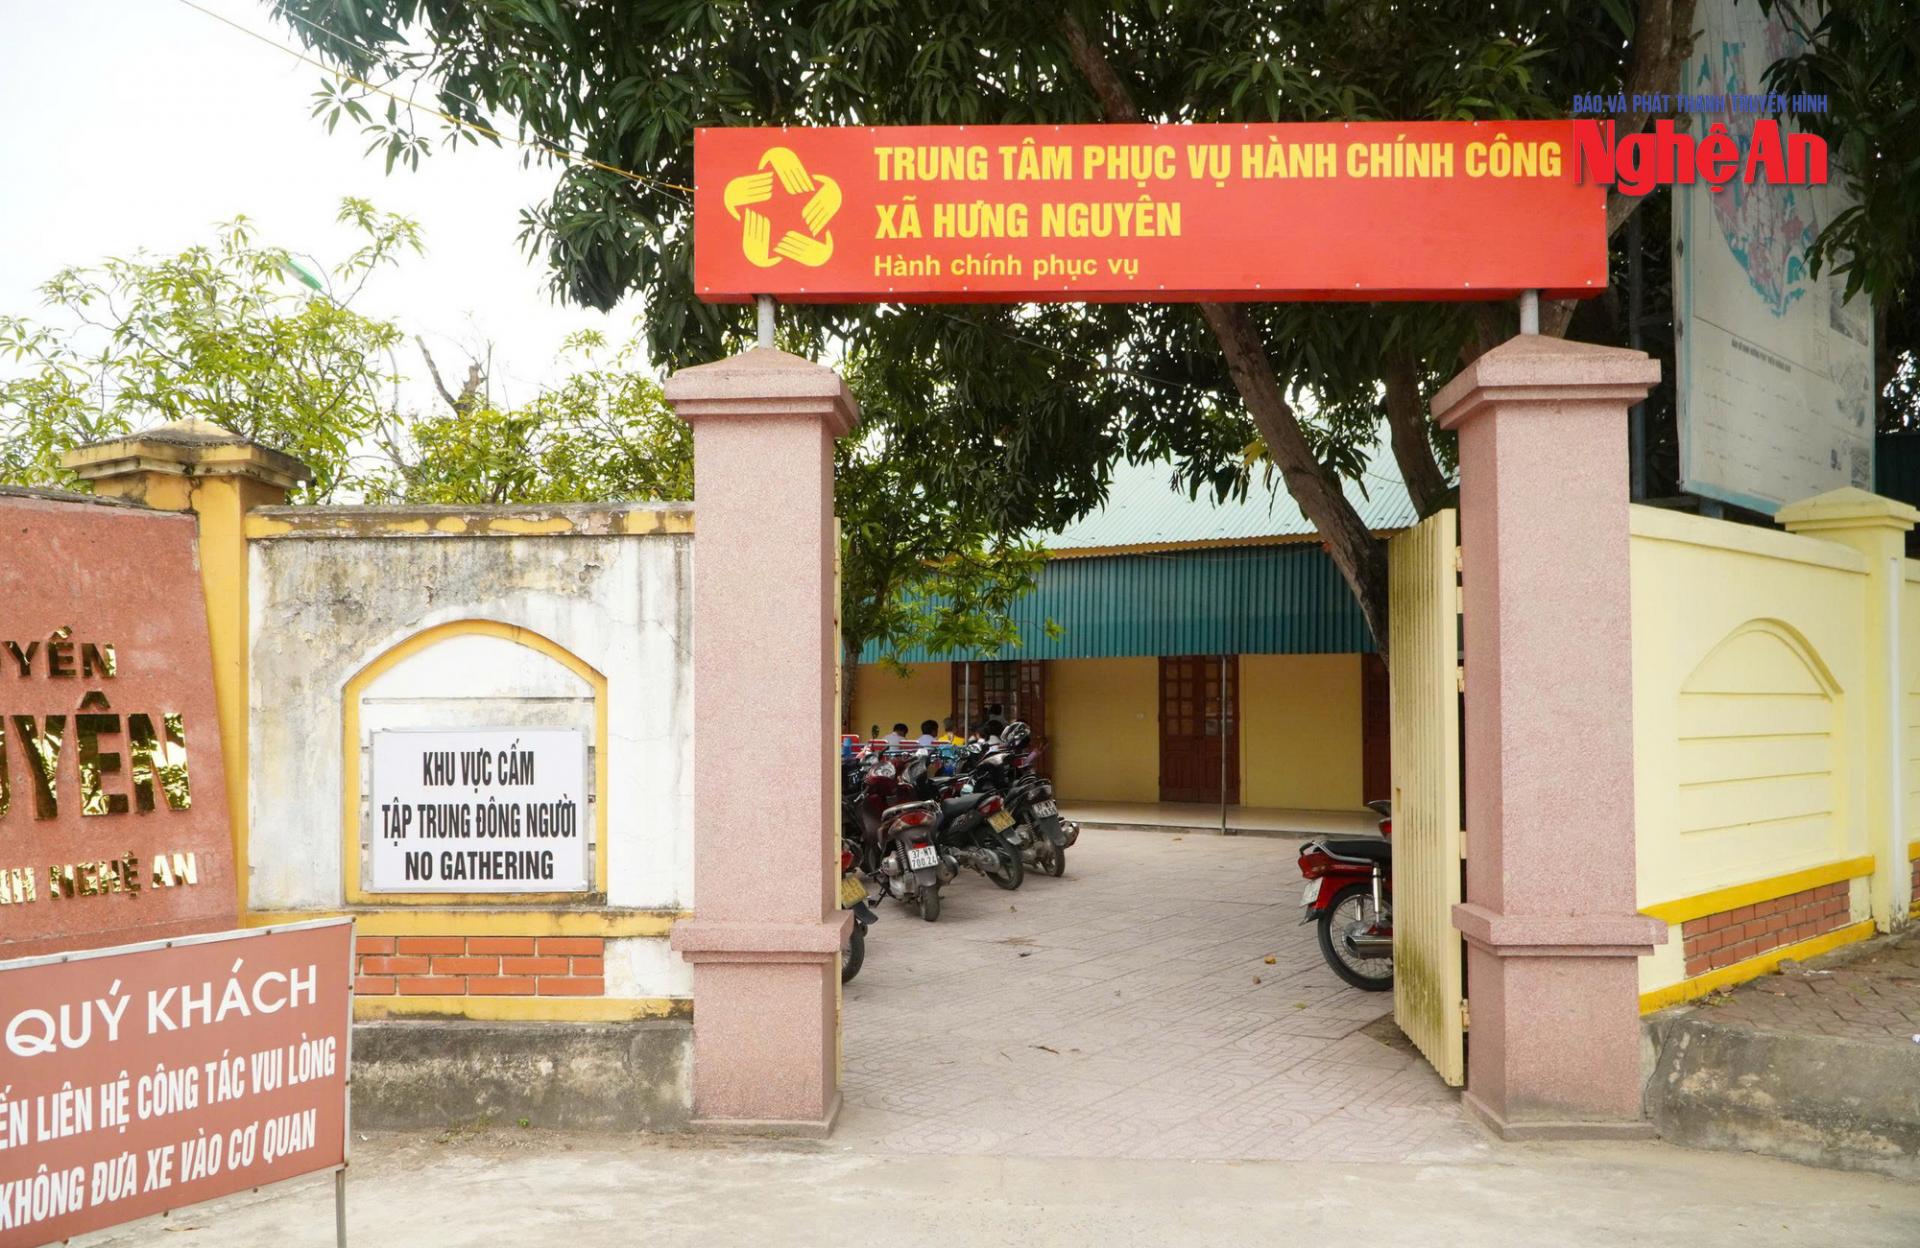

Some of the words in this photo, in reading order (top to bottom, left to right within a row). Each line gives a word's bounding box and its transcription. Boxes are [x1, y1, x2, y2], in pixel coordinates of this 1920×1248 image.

[875, 145, 989, 181] TRUNG
[999, 137, 1072, 180] TÂM
[1083, 145, 1177, 188] PHỤC
[1186, 145, 1231, 188] VỤ
[1242, 136, 1337, 179] HÀNH
[1346, 134, 1455, 179] CHÍNH
[1465, 133, 1562, 178] CÔNG
[874, 195, 922, 239] XÃ
[933, 199, 1028, 238] HƯNG
[1040, 195, 1182, 237] NGUYÊN
[874, 254, 942, 276] Hành
[950, 253, 1022, 275] chính
[1032, 254, 1098, 280] phục
[1107, 256, 1140, 280] vụ
[423, 751, 455, 786] KHU
[460, 747, 493, 794] VỰC
[498, 738, 535, 786] CẤM
[382, 796, 412, 847] TẬP
[417, 804, 471, 839] TRUNG
[475, 796, 521, 838] ĐÔNG
[526, 793, 577, 838] NGƯỜI
[49, 850, 142, 900] NGHỆ
[151, 852, 198, 889] AN
[405, 851, 433, 881] NO
[440, 850, 554, 880] GATHERING
[5, 978, 131, 1057] QUÝ
[147, 957, 317, 1035] KHÁCH
[36, 1080, 93, 1142] LIÊN
[99, 1070, 131, 1134] HỆ
[137, 1063, 199, 1120] CÔNG
[205, 1048, 246, 1105] TÁC
[250, 1047, 283, 1094] VUI
[288, 1032, 337, 1085] LÒNG
[0, 1163, 85, 1232] KHÔNG
[90, 1151, 137, 1208] ĐƯA
[143, 1145, 175, 1193] XE
[181, 1127, 223, 1184] VÀO
[227, 1121, 259, 1171] CƠ
[262, 1108, 317, 1165] QUAN
